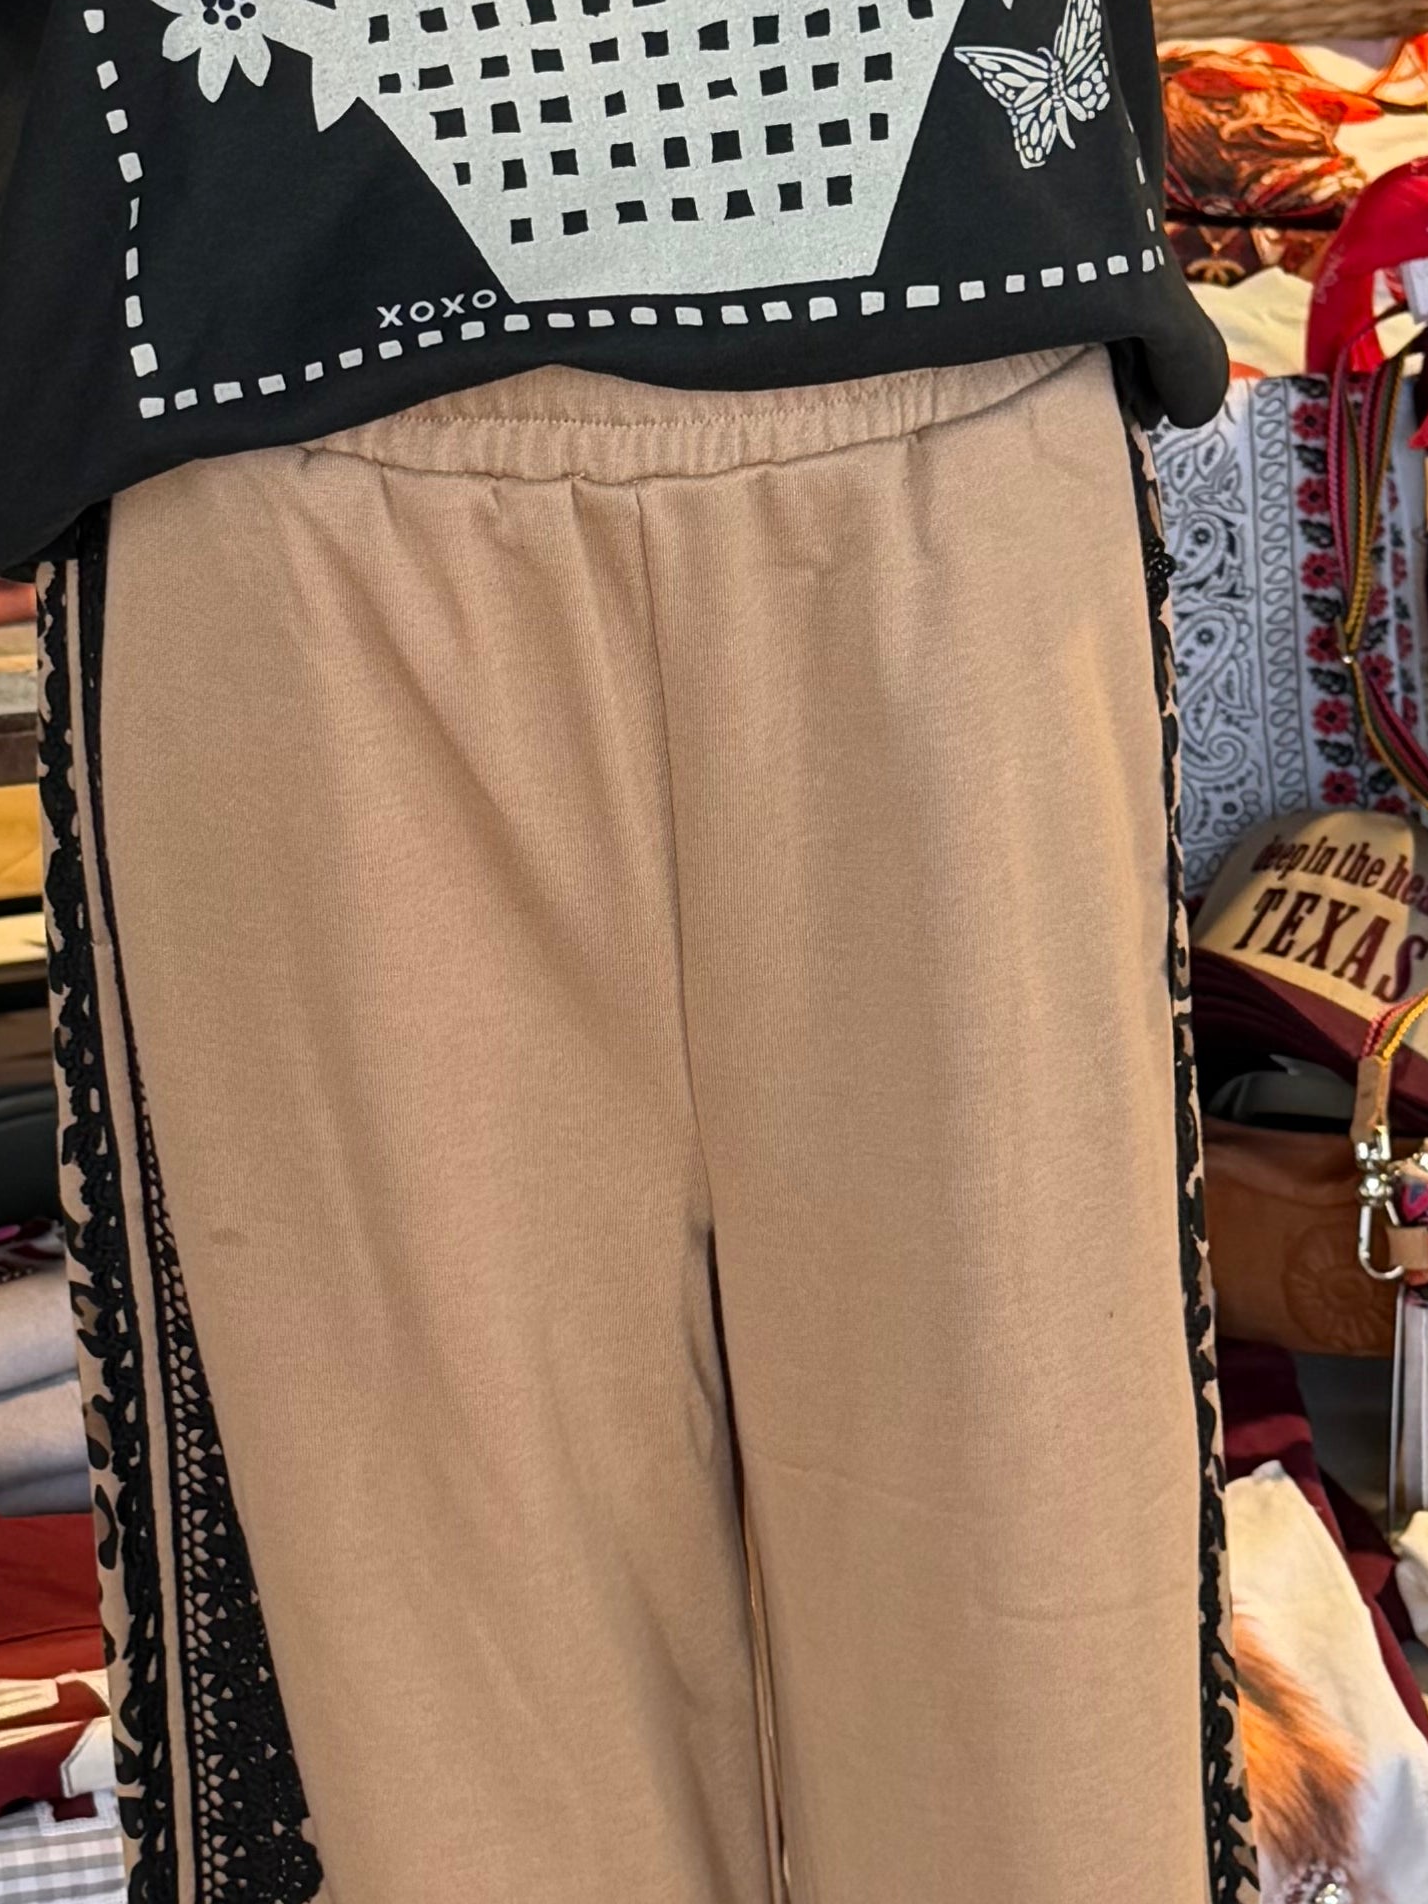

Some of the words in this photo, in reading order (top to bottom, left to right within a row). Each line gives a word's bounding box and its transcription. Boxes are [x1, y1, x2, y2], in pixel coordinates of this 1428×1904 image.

[376, 289, 497, 329] XOXO
[1303, 836, 1337, 877] in
[1334, 842, 1386, 888] the
